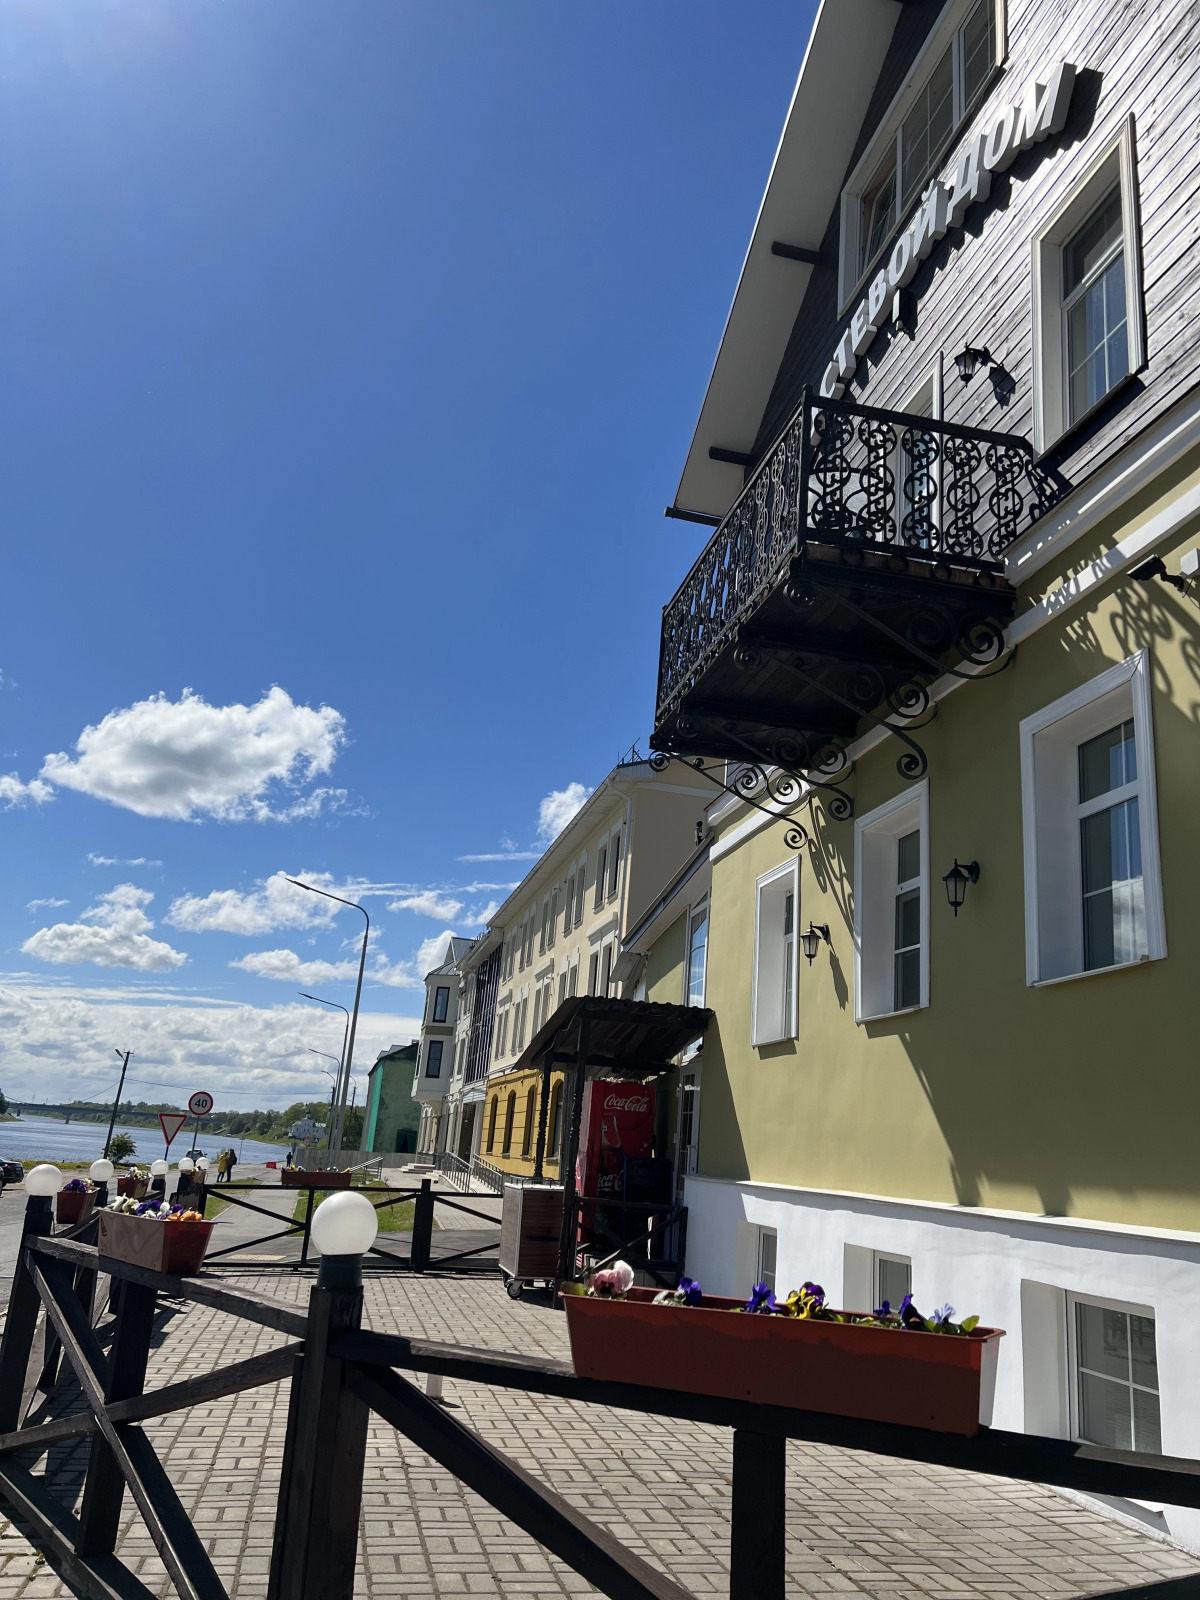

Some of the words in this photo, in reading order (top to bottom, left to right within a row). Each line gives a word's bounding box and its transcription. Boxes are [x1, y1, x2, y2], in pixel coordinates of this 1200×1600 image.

[812, 179, 947, 436] СТЕВОЙ
[946, 62, 1077, 228] ДОМ
[194, 1098, 207, 1108] 40
[604, 1094, 649, 1112] Coca-Cola
